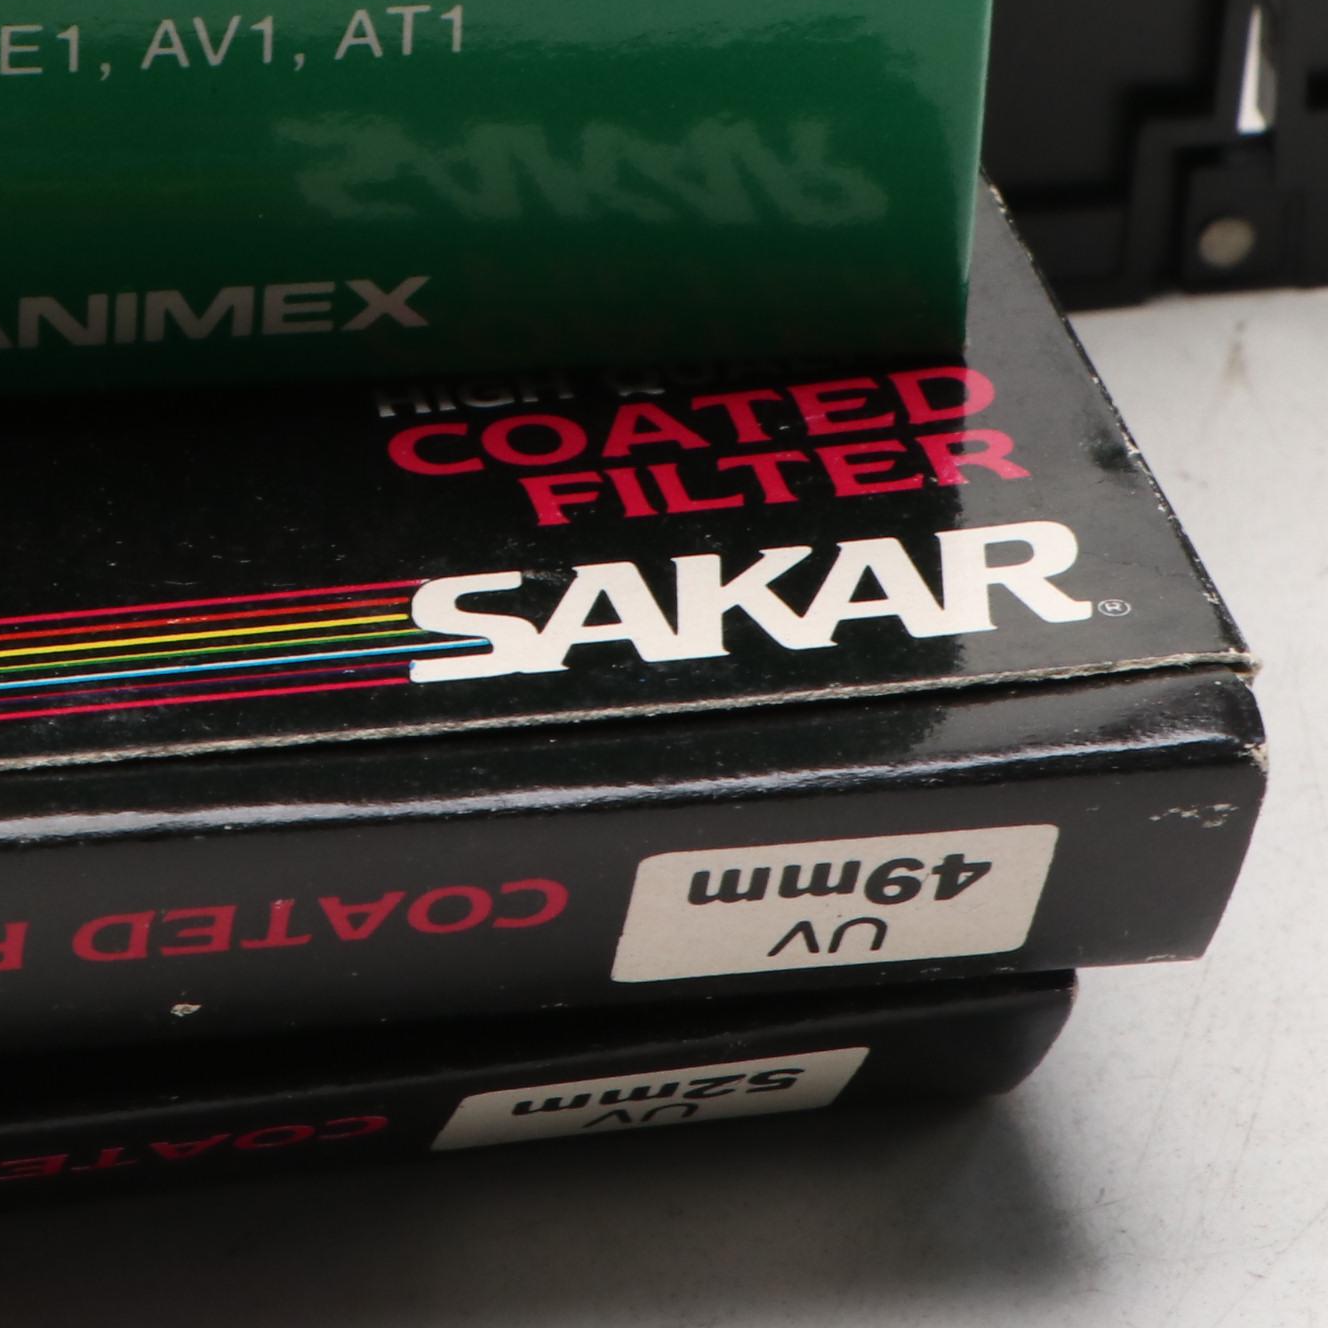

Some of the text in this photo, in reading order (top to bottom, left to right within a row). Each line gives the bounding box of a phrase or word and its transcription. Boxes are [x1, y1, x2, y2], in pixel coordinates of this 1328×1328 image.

[140, 14, 306, 70] AV1,
[334, 5, 465, 60] AT1
[385, 365, 997, 476] COATED
[519, 428, 1032, 527] FILTER
[409, 519, 1094, 685] SAKAR
[687, 852, 993, 906] 49mm
[74, 877, 570, 963] COATED
[766, 916, 890, 958] UV
[511, 1067, 806, 1118] 52mm
[584, 1102, 698, 1129] UV
